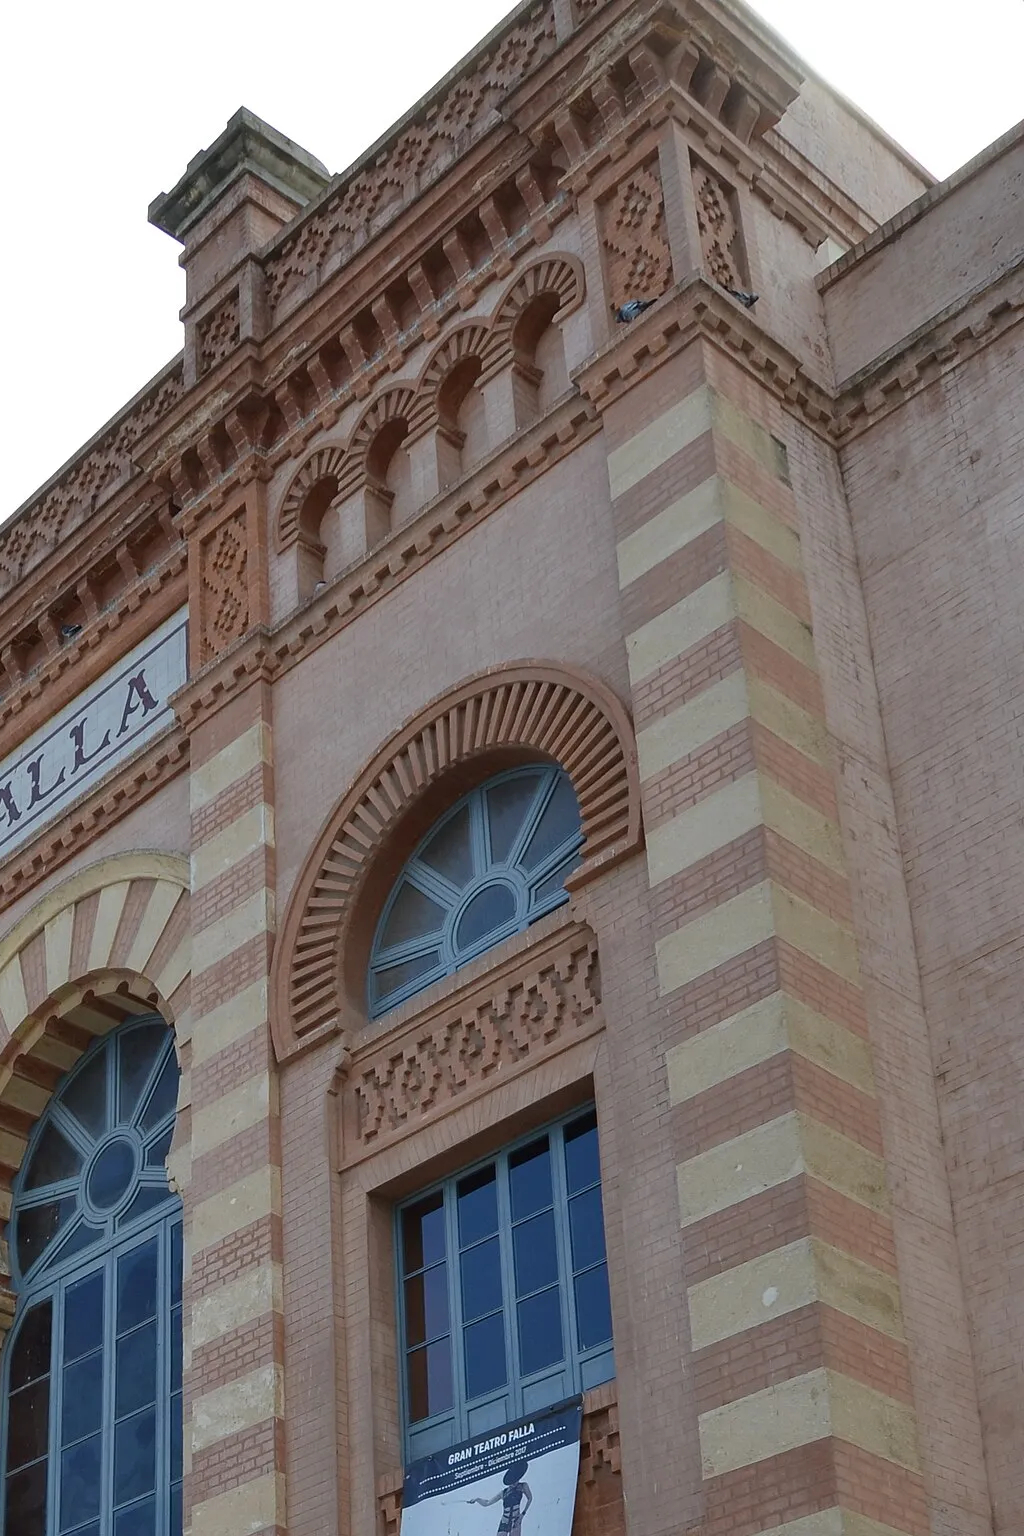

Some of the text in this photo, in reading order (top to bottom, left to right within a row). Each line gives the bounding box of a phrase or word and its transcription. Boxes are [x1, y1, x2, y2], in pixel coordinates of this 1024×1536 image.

[448, 1422, 535, 1465] GRAN TEATRO FALLA
[454, 1464, 484, 1479] Septiembre
[487, 1450, 515, 1467] Diciembre
[514, 1446, 527, 1457] 2017
